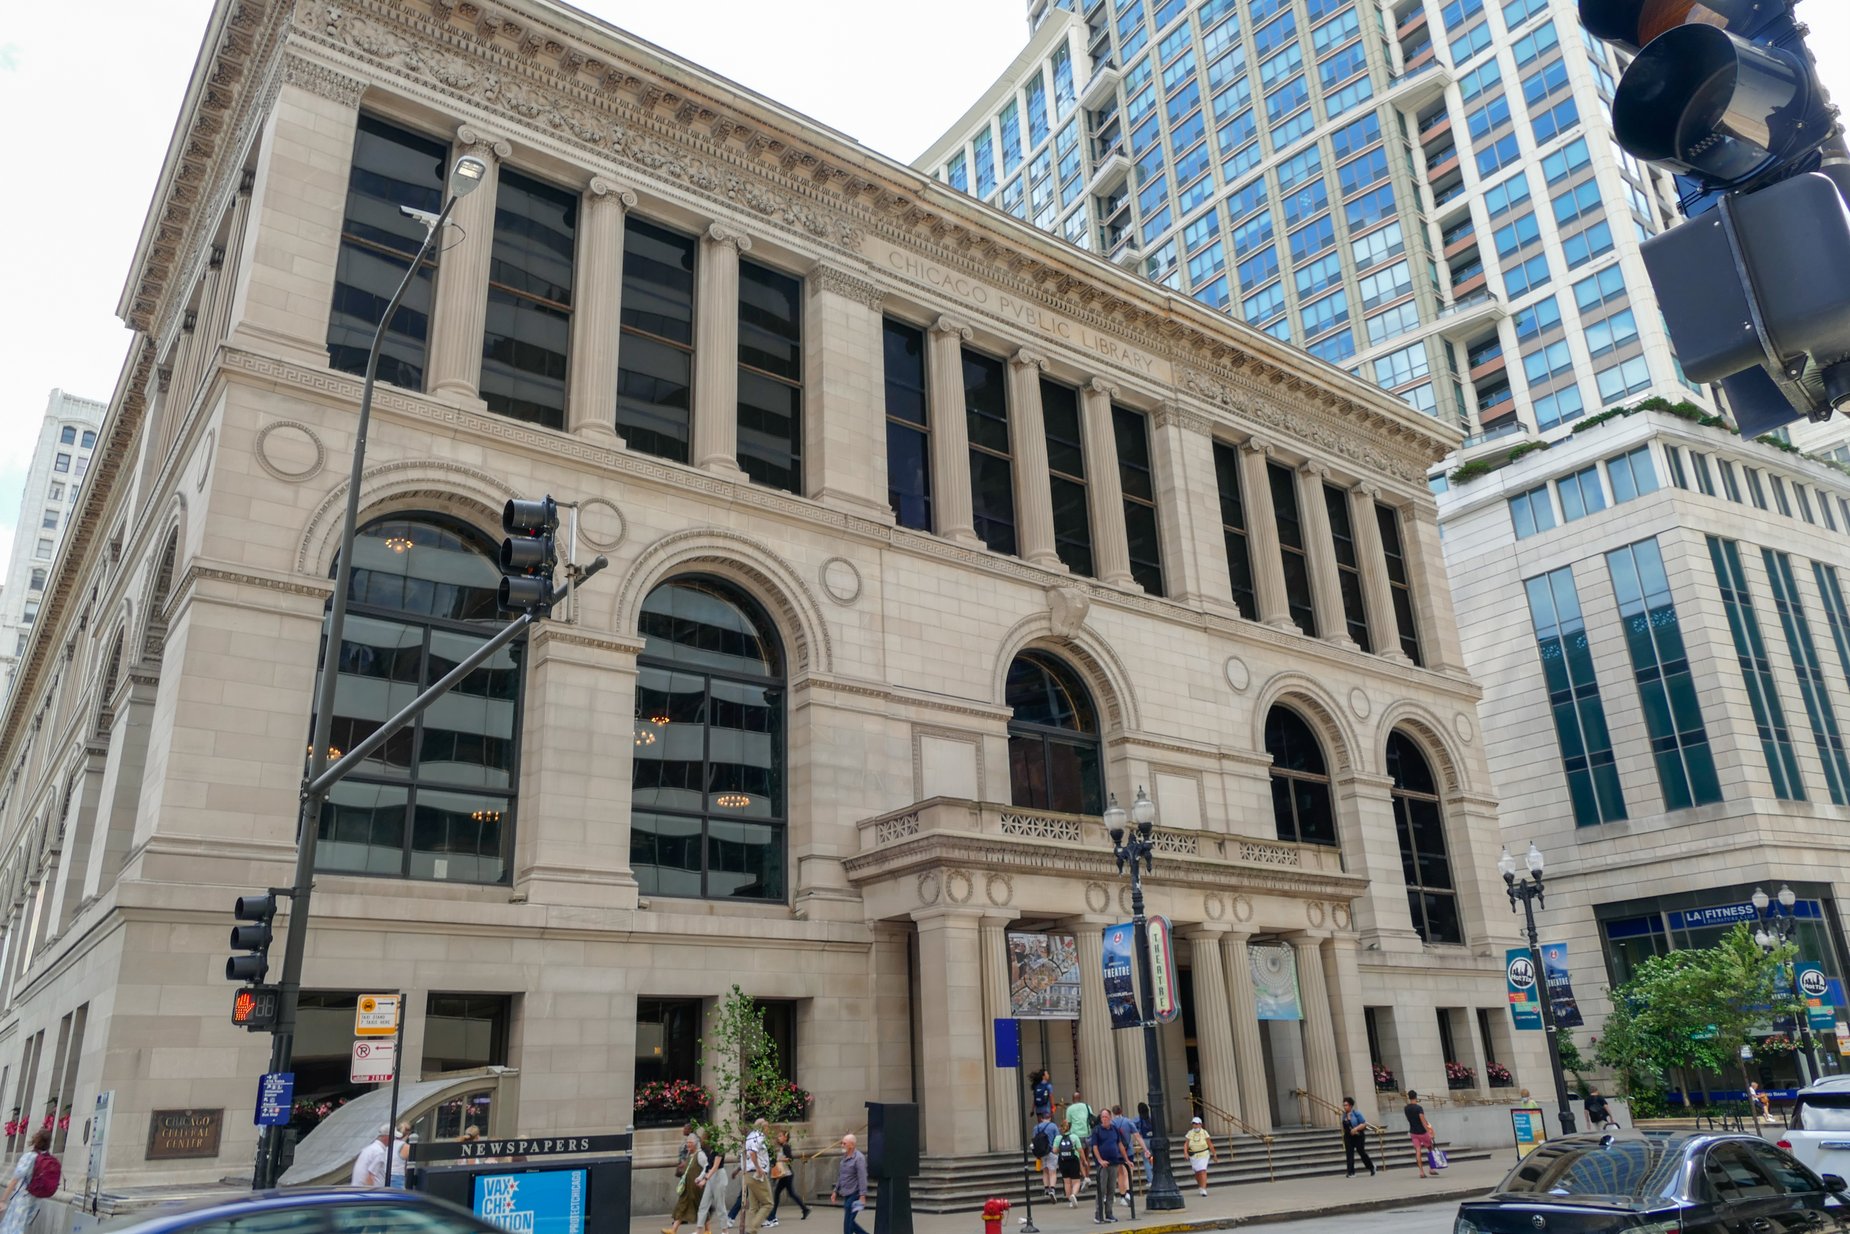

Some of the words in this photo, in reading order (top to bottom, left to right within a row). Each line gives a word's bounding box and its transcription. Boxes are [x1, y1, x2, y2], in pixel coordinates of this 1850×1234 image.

[889, 251, 988, 304] CHICAGO
[1000, 296, 1070, 339] PVBLIC
[1082, 329, 1153, 372] LIBRARY
[1686, 912, 1702, 921] LA
[1705, 905, 1754, 919] FITNESS
[1103, 965, 1131, 979] THEATRE
[1153, 933, 1167, 1008] THEATRE
[1547, 977, 1569, 987] THEATRE
[165, 1116, 210, 1127] CHICAGO
[166, 1138, 203, 1149] CENTER
[461, 1138, 589, 1157] NEWSPAPERS
[486, 1178, 511, 1197] VAX
